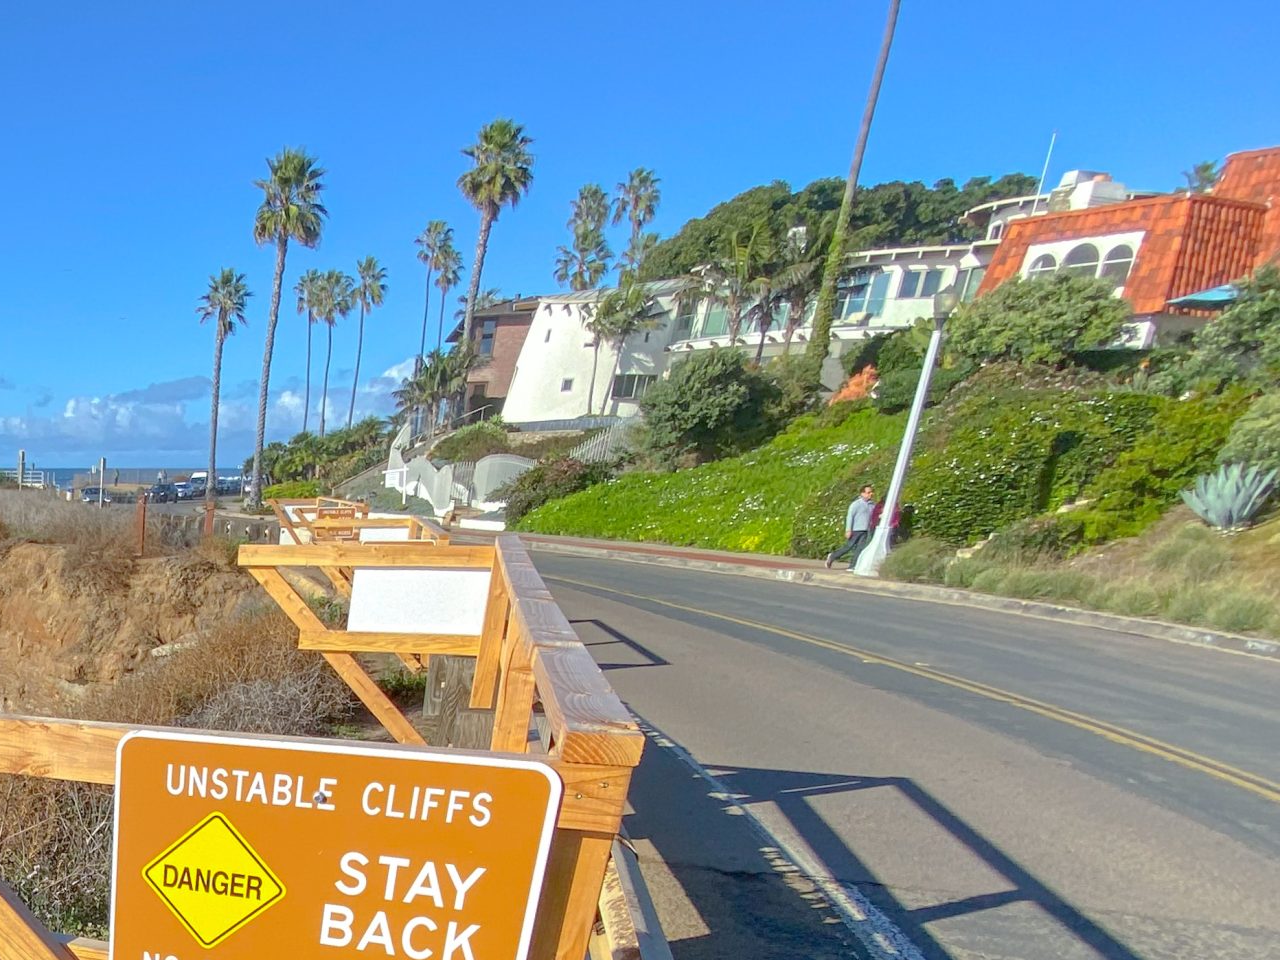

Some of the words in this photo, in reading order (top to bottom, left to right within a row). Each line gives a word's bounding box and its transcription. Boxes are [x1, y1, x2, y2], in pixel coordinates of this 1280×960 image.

[166, 763, 338, 811] UNSTABLE
[361, 781, 493, 827] CLIFFS
[163, 864, 263, 901] DANGER
[334, 851, 487, 911] STAY
